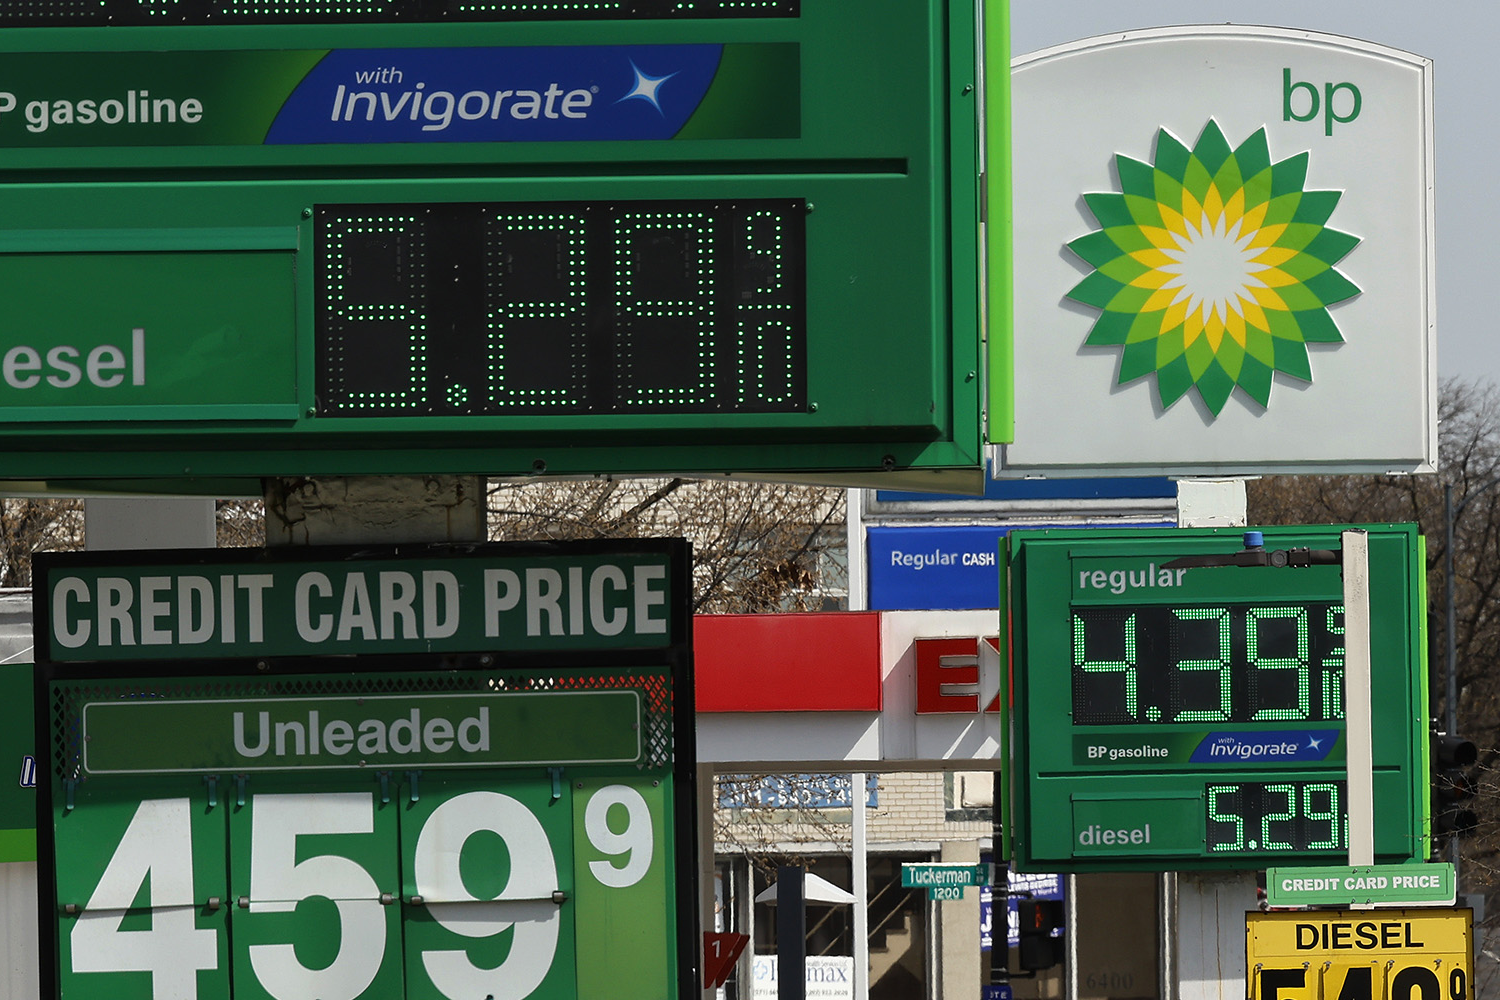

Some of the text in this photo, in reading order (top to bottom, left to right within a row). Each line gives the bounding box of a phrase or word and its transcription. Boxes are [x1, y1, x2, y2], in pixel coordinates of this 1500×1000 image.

[355, 64, 403, 85] with
[25, 90, 204, 133] gasoline
[1282, 67, 1363, 137] bp
[891, 549, 996, 571] Regular CASH
[1079, 562, 1188, 595] regular
[53, 564, 668, 649] CREDIT CARD PRICE
[914, 636, 1000, 716] E
[1073, 606, 1310, 722] 4.39
[232, 706, 491, 759] Unleaded
[1217, 736, 1235, 745] with
[1087, 746, 1107, 758] BP
[1109, 745, 1169, 761] gasoline
[1208, 782, 1340, 852] 5.29
[583, 784, 655, 889] 9
[1079, 824, 1150, 846] diesel
[908, 867, 971, 884] Tuckerman
[1281, 875, 1441, 893] CREDIT CARD PRICE
[933, 887, 960, 900] 1200
[1295, 921, 1425, 951] DIESEL
[1086, 973, 1134, 990] 6400
